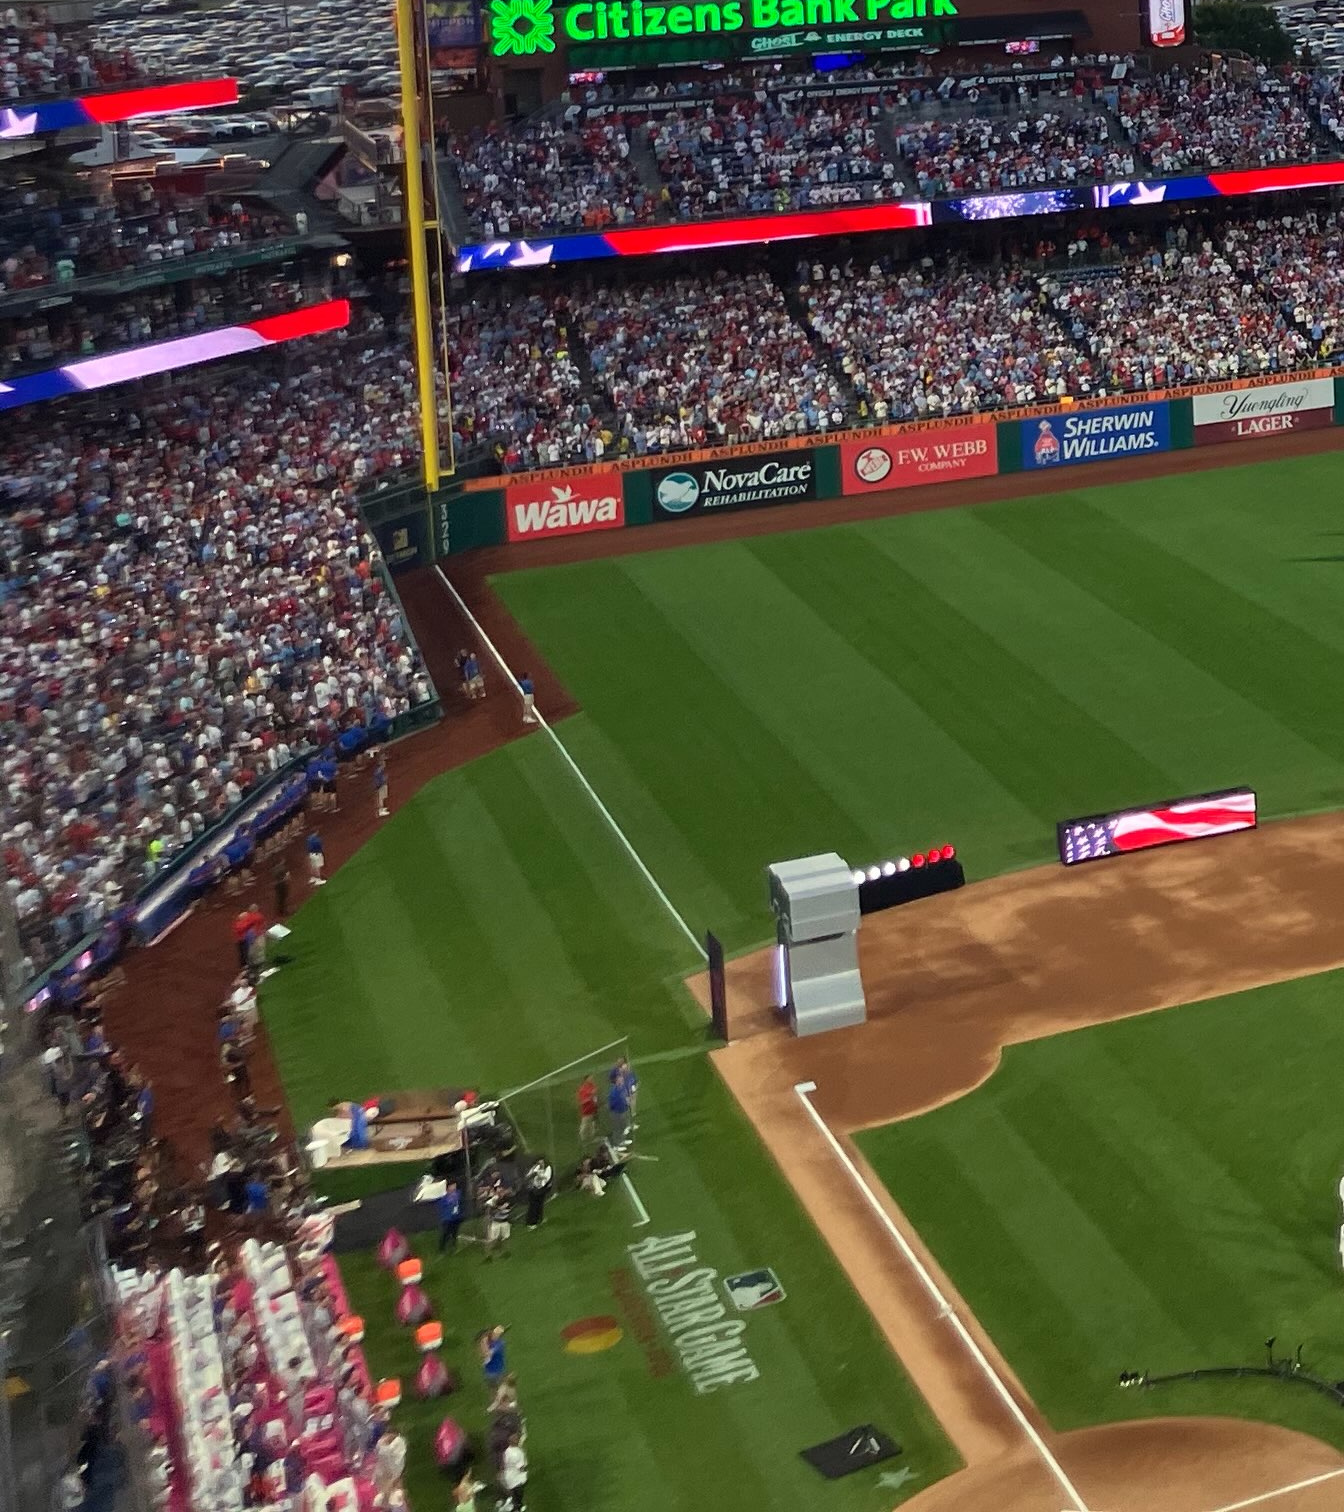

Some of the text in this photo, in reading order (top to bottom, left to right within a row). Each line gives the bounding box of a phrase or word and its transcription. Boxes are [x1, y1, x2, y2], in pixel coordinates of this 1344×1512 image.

[751, 28, 924, 52] GHOST ENERGY DECK
[1164, 380, 1235, 399] ASPLUNDH
[1248, 370, 1317, 388] ASPLUNDH
[1076, 393, 1151, 411] ASPLUNDH
[1220, 386, 1310, 418] Yuengling
[989, 404, 1064, 422] ASPLUNDH
[899, 415, 975, 434] ASPLUNDH
[1063, 411, 1154, 439] SHERWIN
[1236, 415, 1294, 437] LAGER
[804, 428, 884, 447] ASPLUNDH
[709, 440, 791, 459] ASPLUNDH
[897, 439, 989, 467] F.W. WEBB
[610, 452, 694, 473] ASPLUNDH
[917, 458, 967, 474] COMPANY
[507, 465, 594, 486] ASPLUNDH
[701, 462, 810, 493] NovaCare
[703, 483, 808, 508] REHABILITATION
[627, 1230, 698, 1281] ALL
[647, 1268, 727, 1334] STAR
[674, 1320, 760, 1394] GAME
